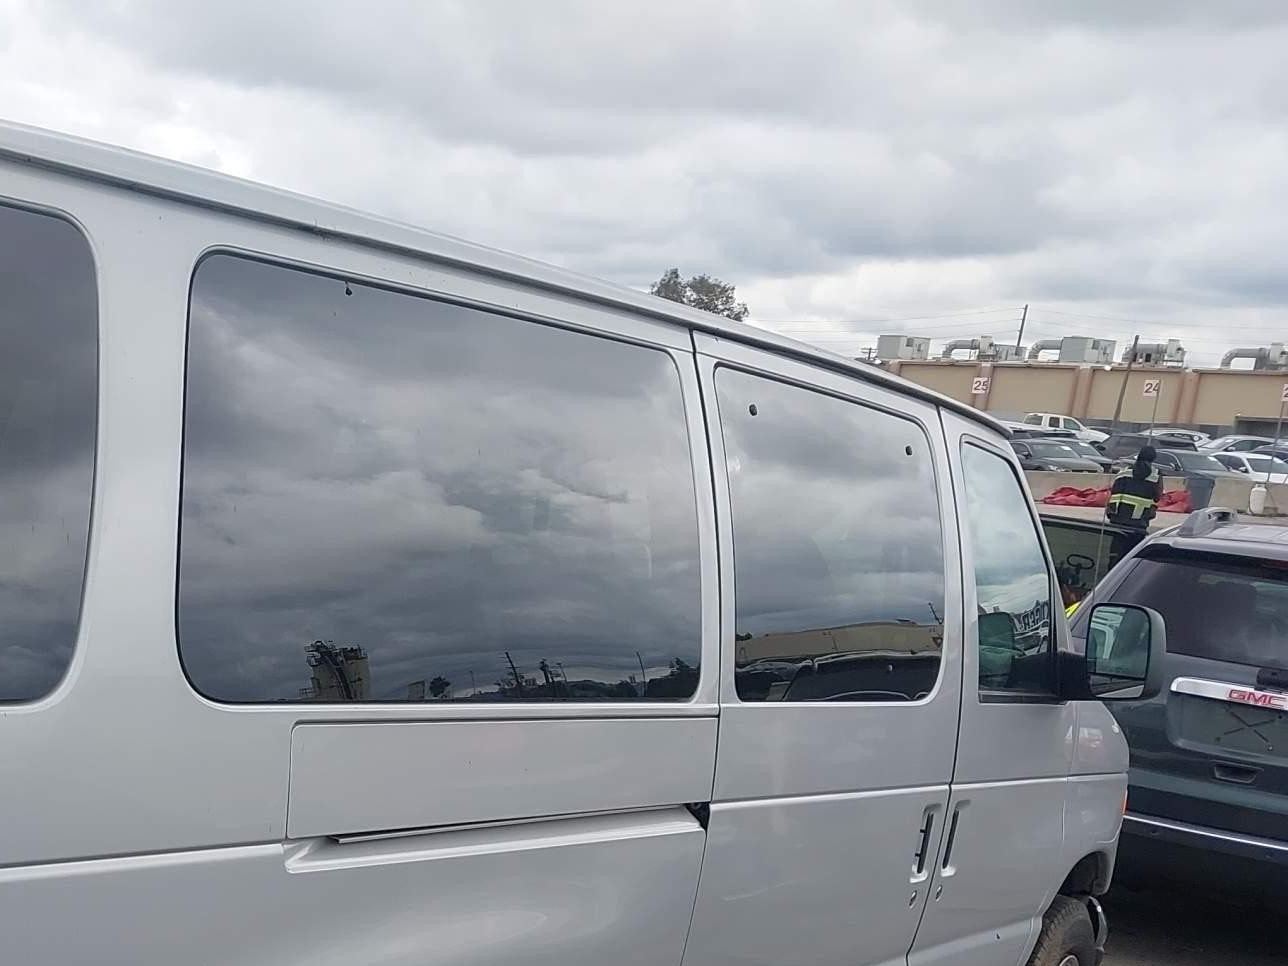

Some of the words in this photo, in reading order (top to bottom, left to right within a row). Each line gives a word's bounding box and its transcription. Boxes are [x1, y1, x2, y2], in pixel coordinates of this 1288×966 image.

[974, 380, 989, 391] 25
[1144, 382, 1160, 394] 24
[1228, 689, 1286, 709] GMC
